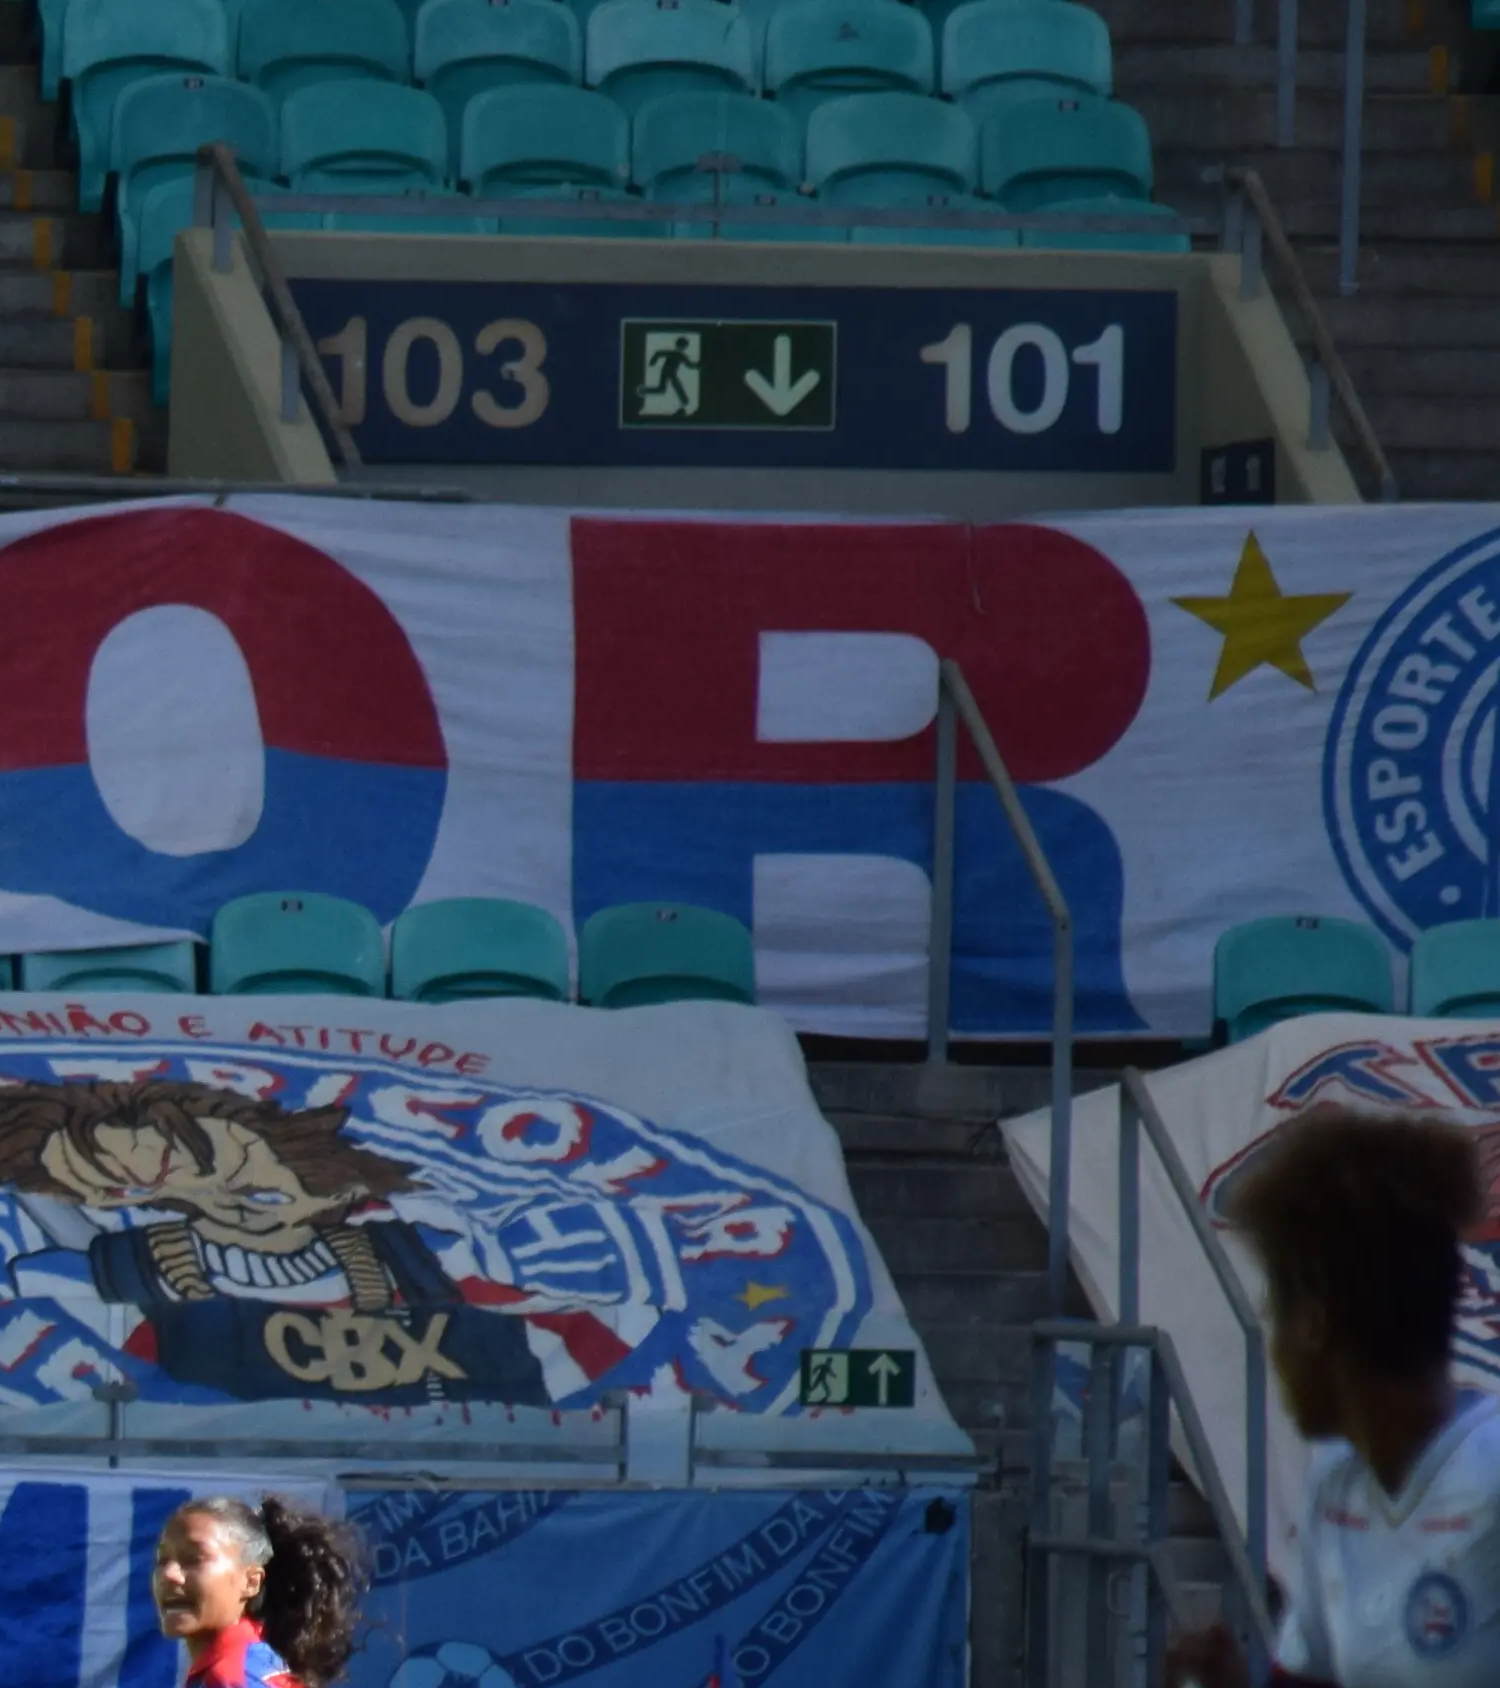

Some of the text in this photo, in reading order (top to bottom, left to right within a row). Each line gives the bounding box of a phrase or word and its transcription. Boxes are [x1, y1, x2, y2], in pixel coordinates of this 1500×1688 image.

[319, 317, 551, 430] 103
[920, 323, 1126, 433] 101
[179, 1014, 212, 1038] E
[247, 1021, 492, 1076] ATITUDE
[49, 1057, 797, 1261] TRICOLR
[264, 1309, 467, 1392] CBX
[523, 1499, 824, 1684] DO BONFIM DA
[760, 1489, 894, 1645] BONFIM
